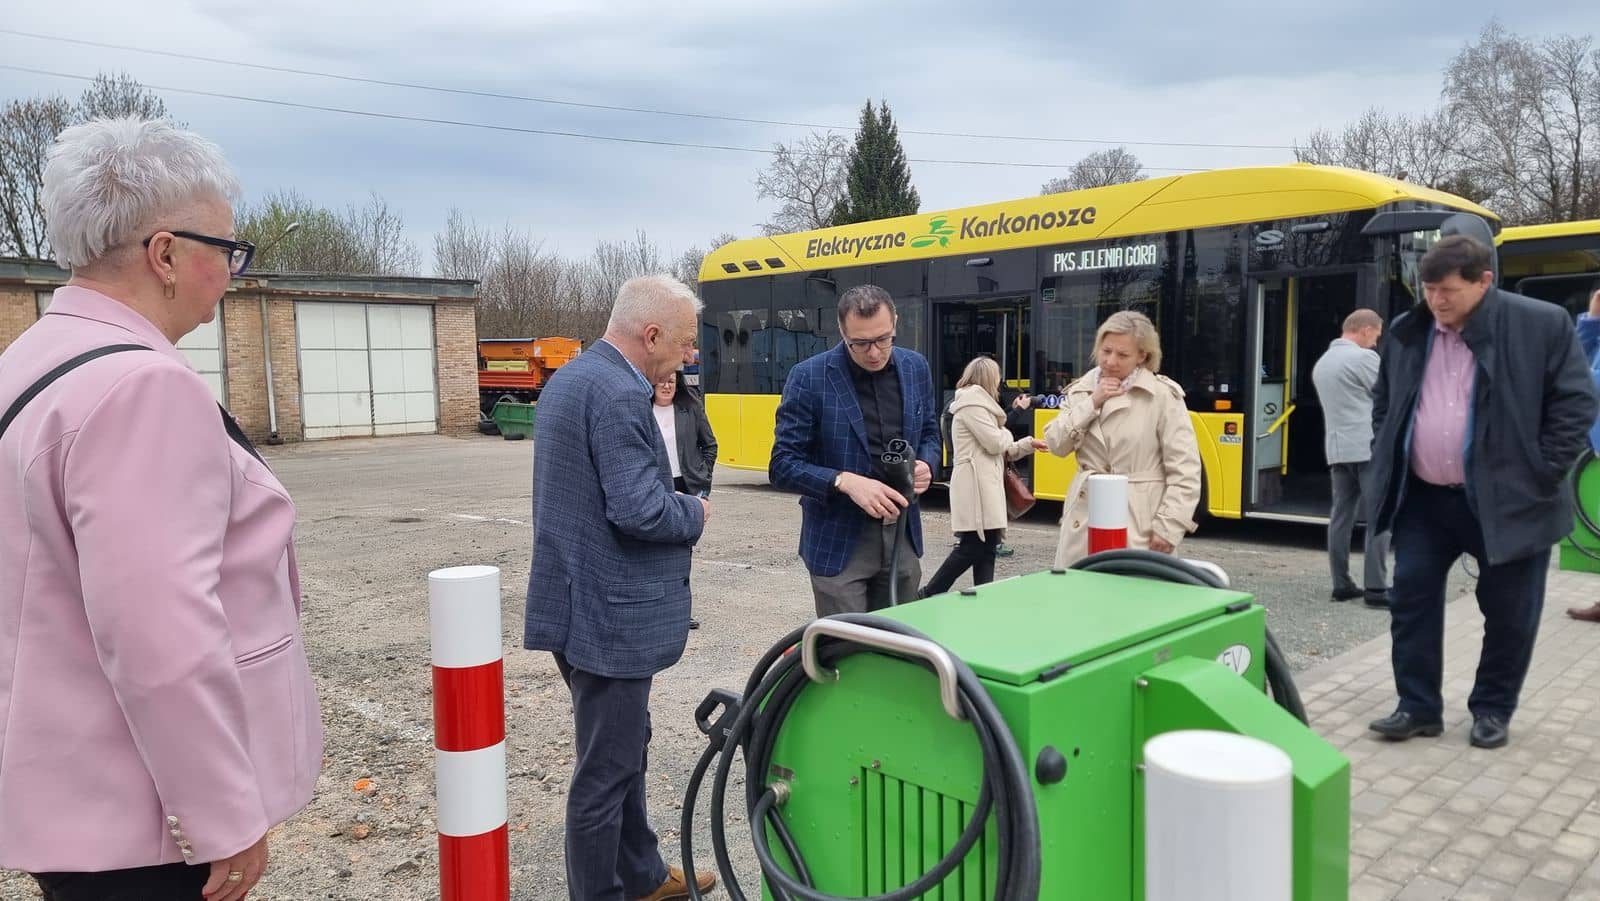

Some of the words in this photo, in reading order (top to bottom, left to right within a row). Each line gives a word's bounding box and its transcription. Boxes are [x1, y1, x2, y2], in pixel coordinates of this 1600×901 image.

[806, 231, 906, 258] Elektryczne
[960, 206, 1097, 240] Karkonosze
[1053, 252, 1076, 272] PKS
[1077, 247, 1123, 269] JELENIA
